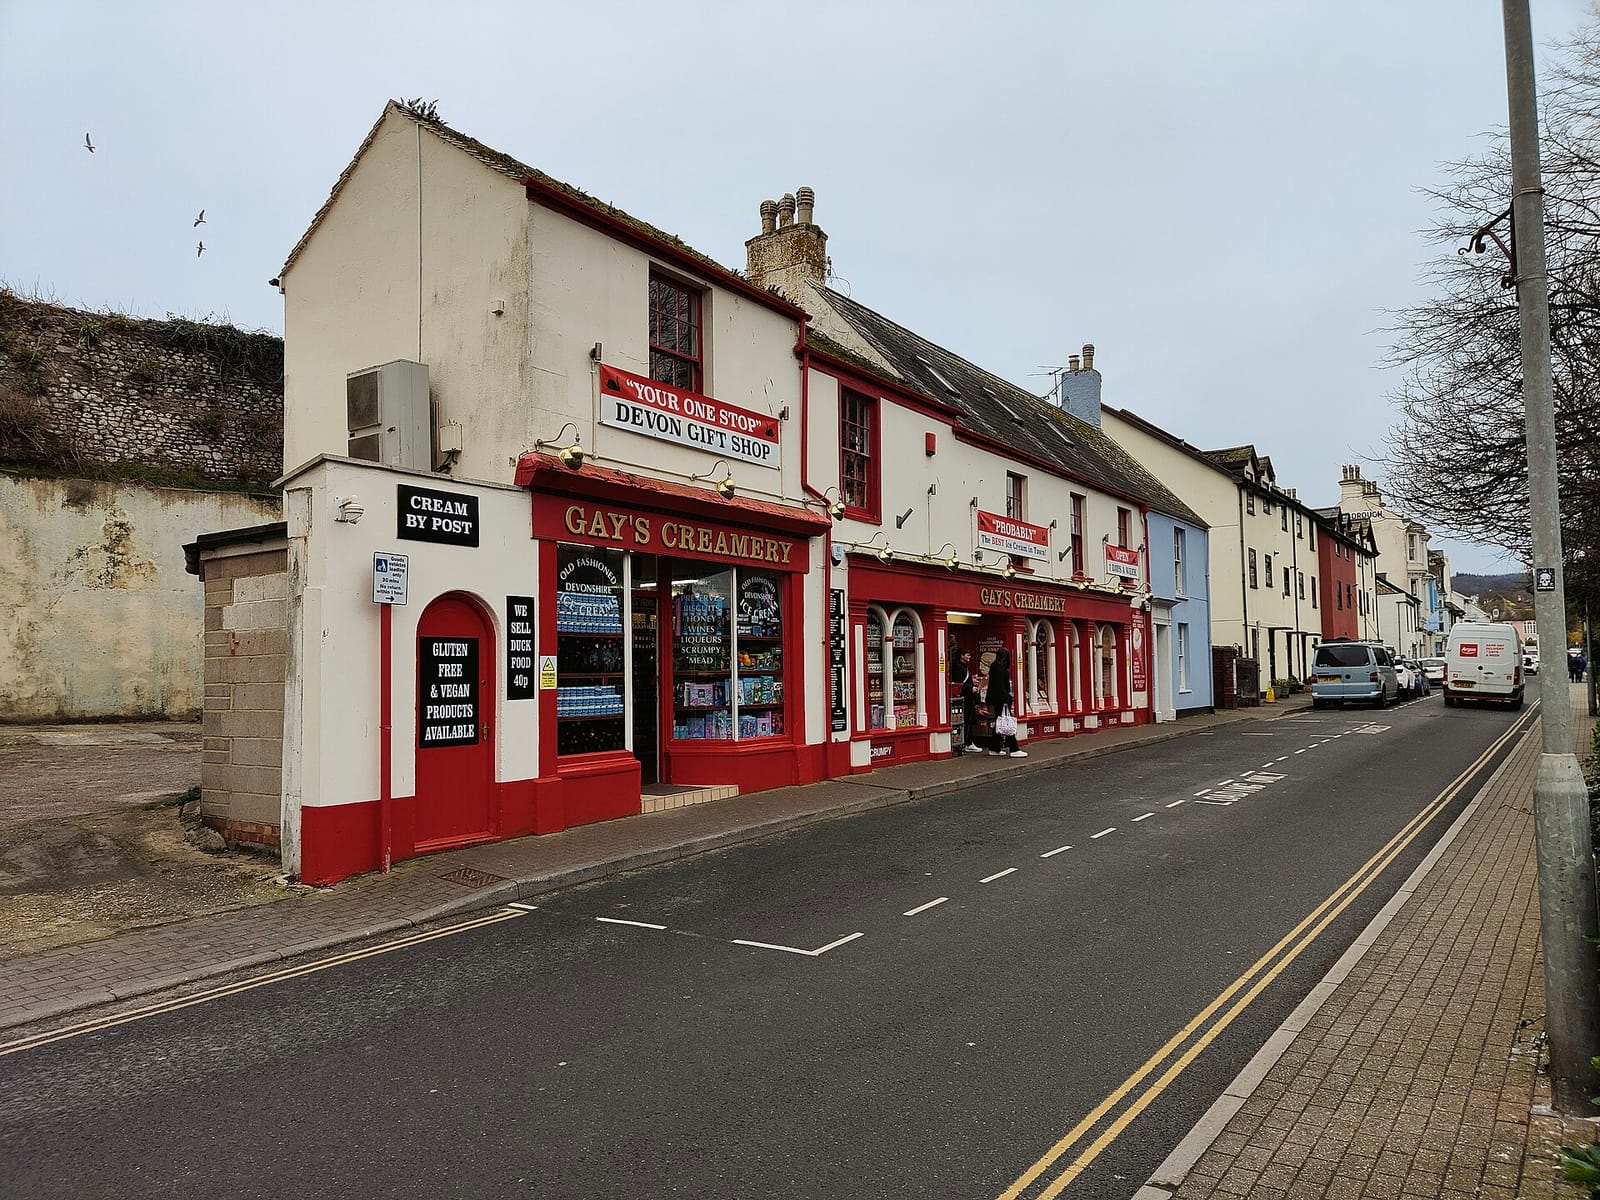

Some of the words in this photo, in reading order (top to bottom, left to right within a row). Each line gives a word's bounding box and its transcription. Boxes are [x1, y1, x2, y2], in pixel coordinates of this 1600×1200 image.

[684, 399, 716, 421] ONE
[615, 402, 682, 437] DEVON
[687, 422, 727, 449] GIFT
[731, 435, 771, 461] SHOP
[410, 495, 469, 517] CREAM
[405, 513, 428, 529] BY
[431, 517, 473, 535] POST
[564, 505, 651, 545] GAY'S
[661, 521, 793, 564] CREAMERY
[981, 534, 991, 544] The
[992, 536, 1004, 547] BEST
[1012, 541, 1028, 552] Cream
[560, 562, 575, 580] OLD
[576, 557, 617, 585] FASHIONED
[566, 582, 612, 594] DEVONSHIRE
[560, 593, 578, 612] ICE
[580, 598, 620, 616] CREAMS
[740, 598, 752, 616] ICE
[981, 588, 1011, 607] GAY'S
[1014, 592, 1066, 612] CREAMERY
[514, 604, 528, 616] WE
[511, 622, 532, 634] SELL
[510, 640, 532, 652] DUCK
[681, 636, 722, 645] LIQUEURS
[432, 642, 468, 656] GLUTEN
[512, 656, 531, 668] FOOD
[438, 664, 463, 678] FREE
[514, 674, 528, 688] 40p
[430, 684, 438, 698] &
[440, 684, 470, 698] VEGAN
[426, 704, 474, 720] PRODUCTS
[424, 724, 474, 741] AVAILABLE
[870, 746, 892, 758] CRUMPY
